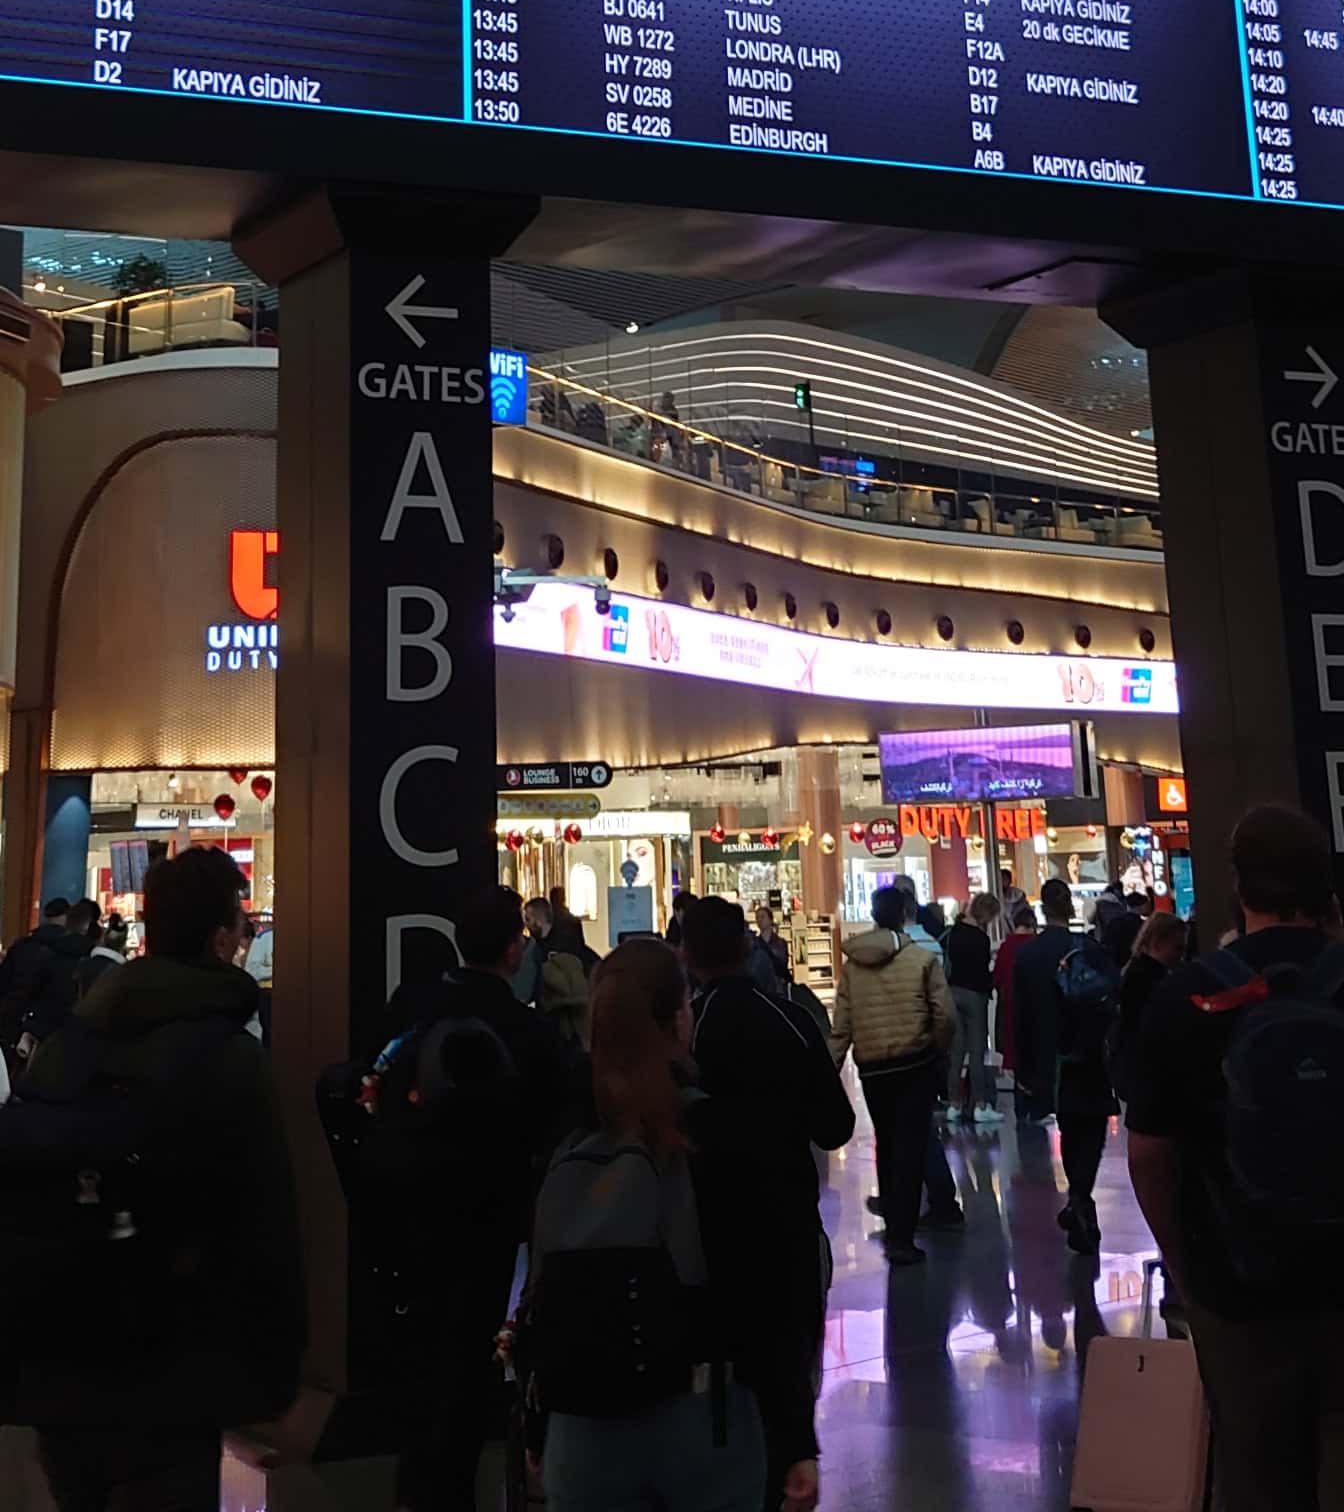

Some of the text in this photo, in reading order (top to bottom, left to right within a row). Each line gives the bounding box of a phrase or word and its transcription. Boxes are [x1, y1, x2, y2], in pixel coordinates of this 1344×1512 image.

[964, 11, 984, 32] E4
[1022, 19, 1040, 38] 20
[1042, 22, 1060, 41] dk
[1062, 24, 1130, 50] GECİKME
[94, 59, 121, 84] D2
[173, 67, 245, 95] KAPIYA
[248, 73, 320, 103] GİDİNİZ
[1253, 99, 1288, 120] 14:20
[358, 361, 485, 404] GATES
[380, 431, 465, 544] A
[386, 585, 453, 702] B
[523, 767, 589, 777] LOUNGE 160
[523, 775, 560, 785] BUSINESS
[379, 745, 459, 867] C
[899, 803, 971, 838] DUTY
